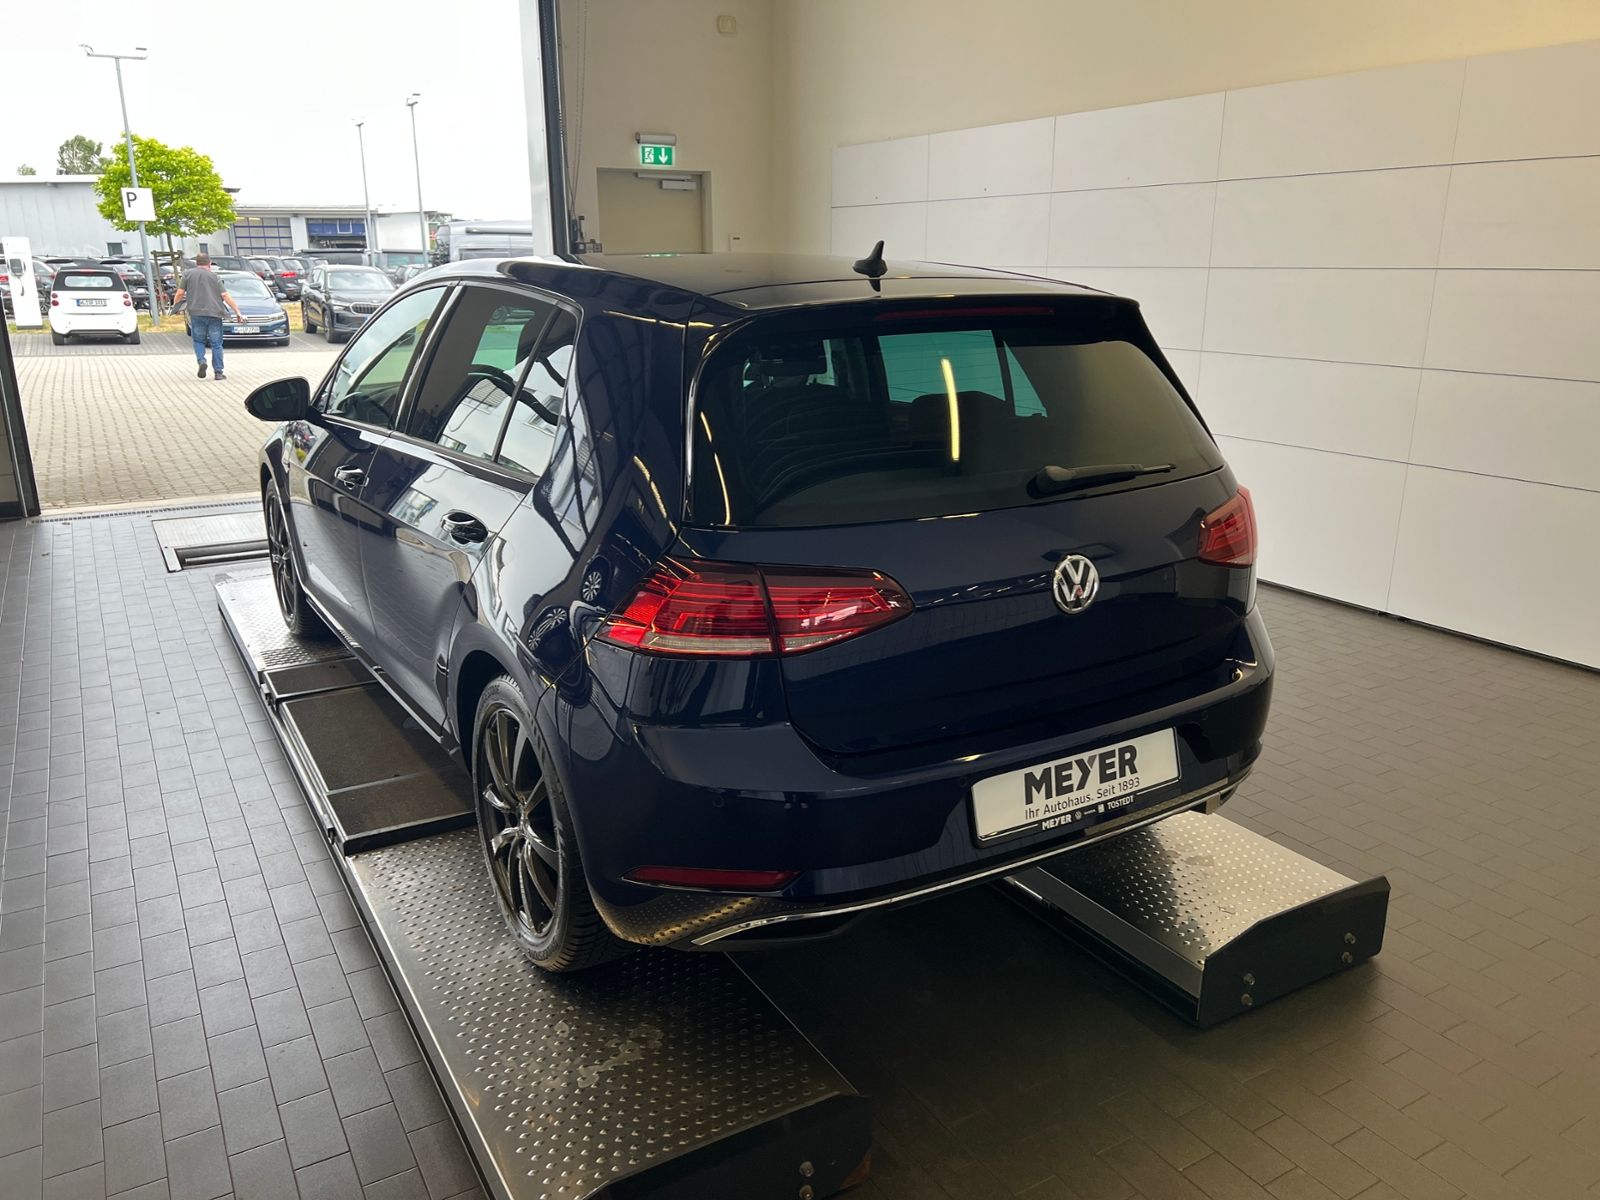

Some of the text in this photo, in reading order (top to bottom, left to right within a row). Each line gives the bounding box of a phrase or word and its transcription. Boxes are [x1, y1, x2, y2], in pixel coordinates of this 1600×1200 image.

[126, 192, 137, 208] P
[1024, 745, 1138, 806] MEYER
[1025, 808, 1040, 820] Ihr
[1043, 795, 1094, 815] Autohaus.
[1096, 785, 1115, 799] Seit
[1118, 777, 1140, 792] 1893
[1042, 795, 1134, 830] MEYER TOSTEDT
